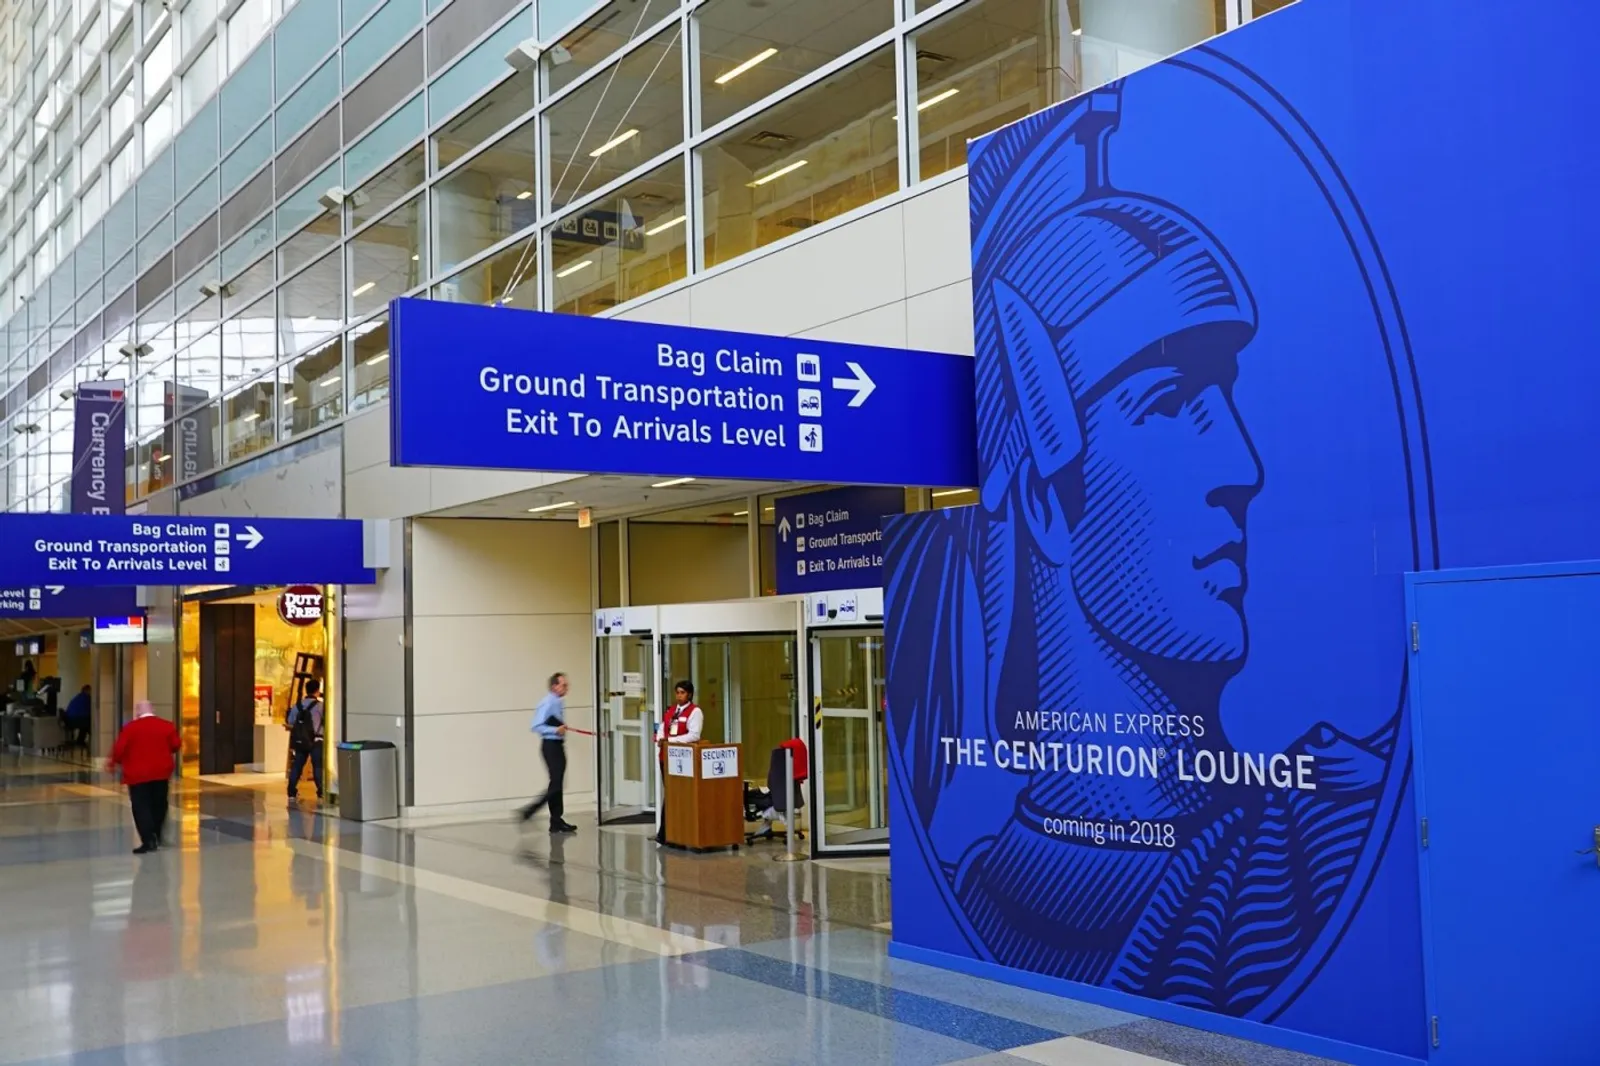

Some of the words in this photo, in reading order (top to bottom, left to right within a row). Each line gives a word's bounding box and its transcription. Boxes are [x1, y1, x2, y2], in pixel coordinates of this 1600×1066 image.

[657, 343, 705, 376] Bag
[715, 349, 783, 377] Claim
[480, 367, 585, 398] Ground
[596, 375, 784, 412] Transportation
[506, 408, 558, 436] Exit
[568, 412, 602, 438] To
[613, 415, 711, 444] Arrivals
[722, 420, 786, 447] Level
[87, 412, 109, 500] Currency
[808, 513, 824, 527] Bag
[826, 509, 849, 523] Claim
[132, 523, 161, 538] Bag
[166, 523, 207, 536] Claim
[35, 539, 93, 552] Ground
[98, 540, 207, 556] Transportation
[809, 534, 838, 549] Ground
[48, 557, 77, 570] Exit
[82, 557, 101, 570] To
[106, 558, 163, 570] Arrivals
[169, 558, 208, 570] Level
[809, 560, 824, 573] Exit
[826, 558, 836, 571] To
[837, 555, 870, 570] Arrivals
[872, 554, 883, 566] Le
[285, 593, 322, 605] DUTY
[286, 605, 321, 618] FREE
[1014, 710, 1107, 733] AMERICAN
[1114, 713, 1205, 737] EXPRESS
[669, 748, 692, 758] SECURITY
[703, 749, 736, 760] SECURITY
[941, 737, 987, 767] THE
[1177, 749, 1317, 790] LOUNGE
[1043, 816, 1105, 845] coming
[1109, 819, 1125, 842] in
[1129, 820, 1175, 849] 2018
